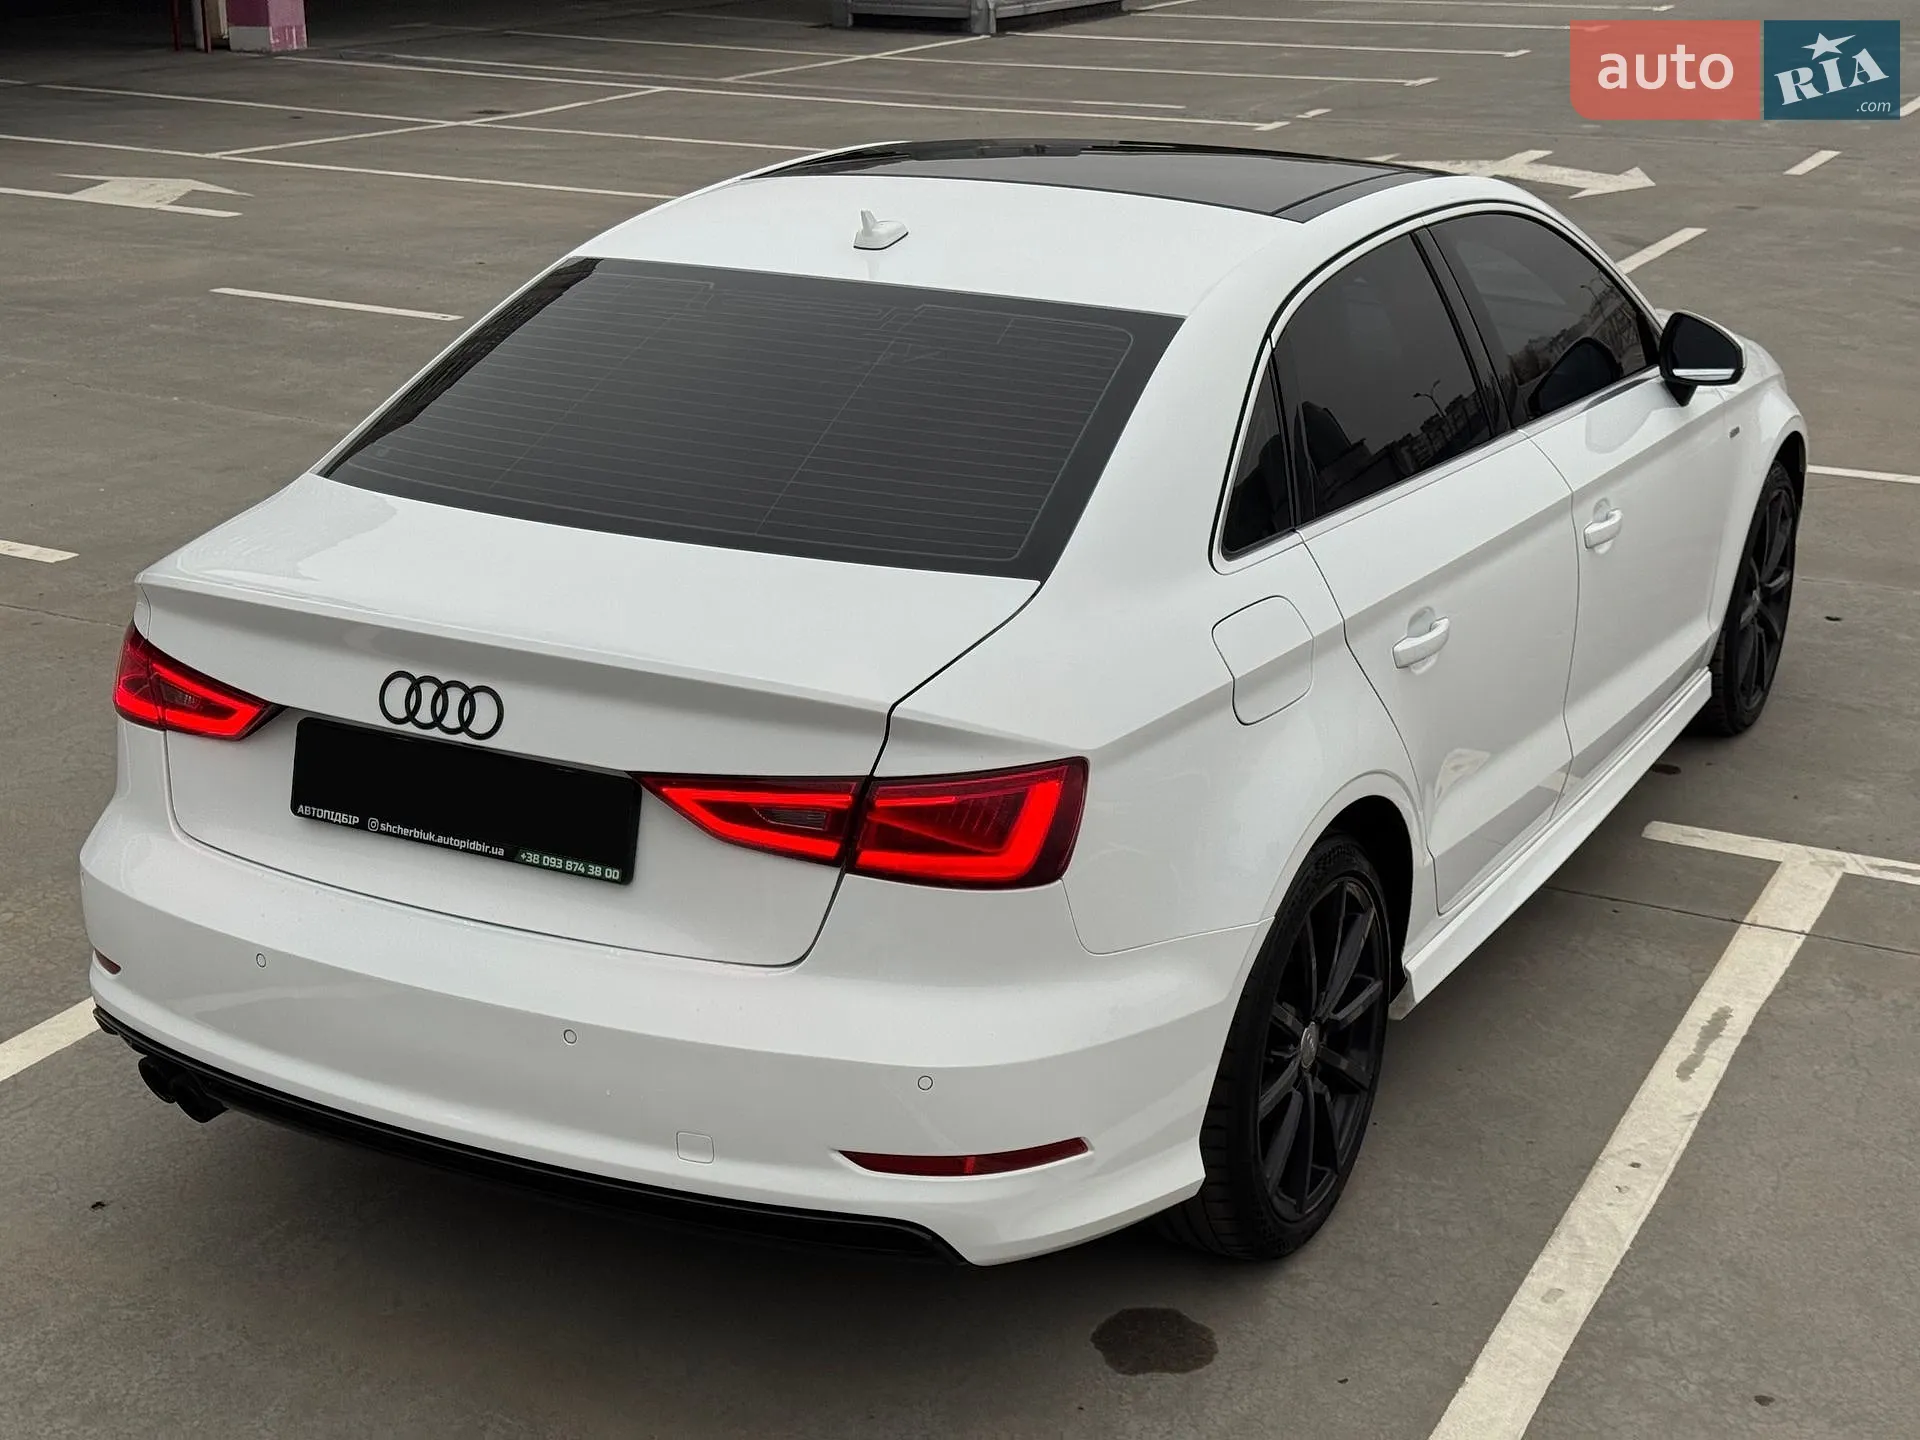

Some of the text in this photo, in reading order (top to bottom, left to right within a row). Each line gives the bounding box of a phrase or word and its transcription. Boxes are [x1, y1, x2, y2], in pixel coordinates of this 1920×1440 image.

[297, 804, 360, 825] АВТОПІДБІР
[379, 821, 505, 856] shcherbiuk.autopidbir.ua
[520, 852, 620, 880] +38 093 874 38 00
